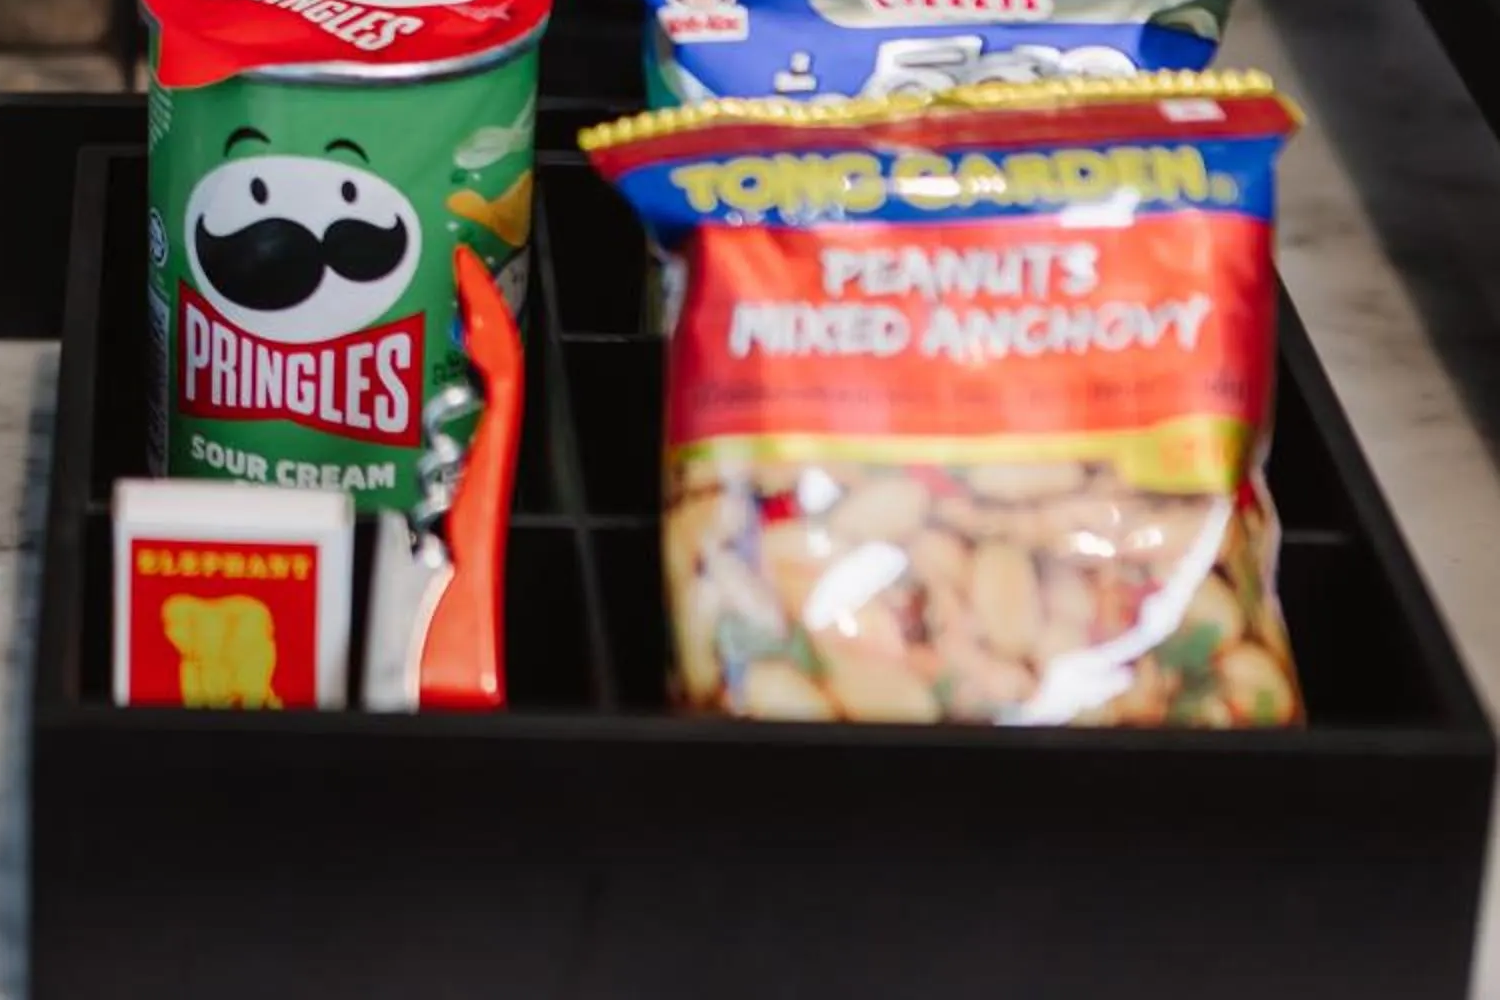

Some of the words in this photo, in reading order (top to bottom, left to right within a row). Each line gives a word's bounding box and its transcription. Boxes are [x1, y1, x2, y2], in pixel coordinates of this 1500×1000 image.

[671, 149, 886, 216] TONG
[890, 145, 1212, 211] GARDEN
[728, 301, 911, 360] MIXED
[921, 294, 1212, 360] ANCHOVY
[184, 301, 412, 435] PRINGLES
[190, 434, 268, 479] SOUR
[276, 458, 396, 491] CREAM
[137, 549, 312, 582] ELEPHANT
